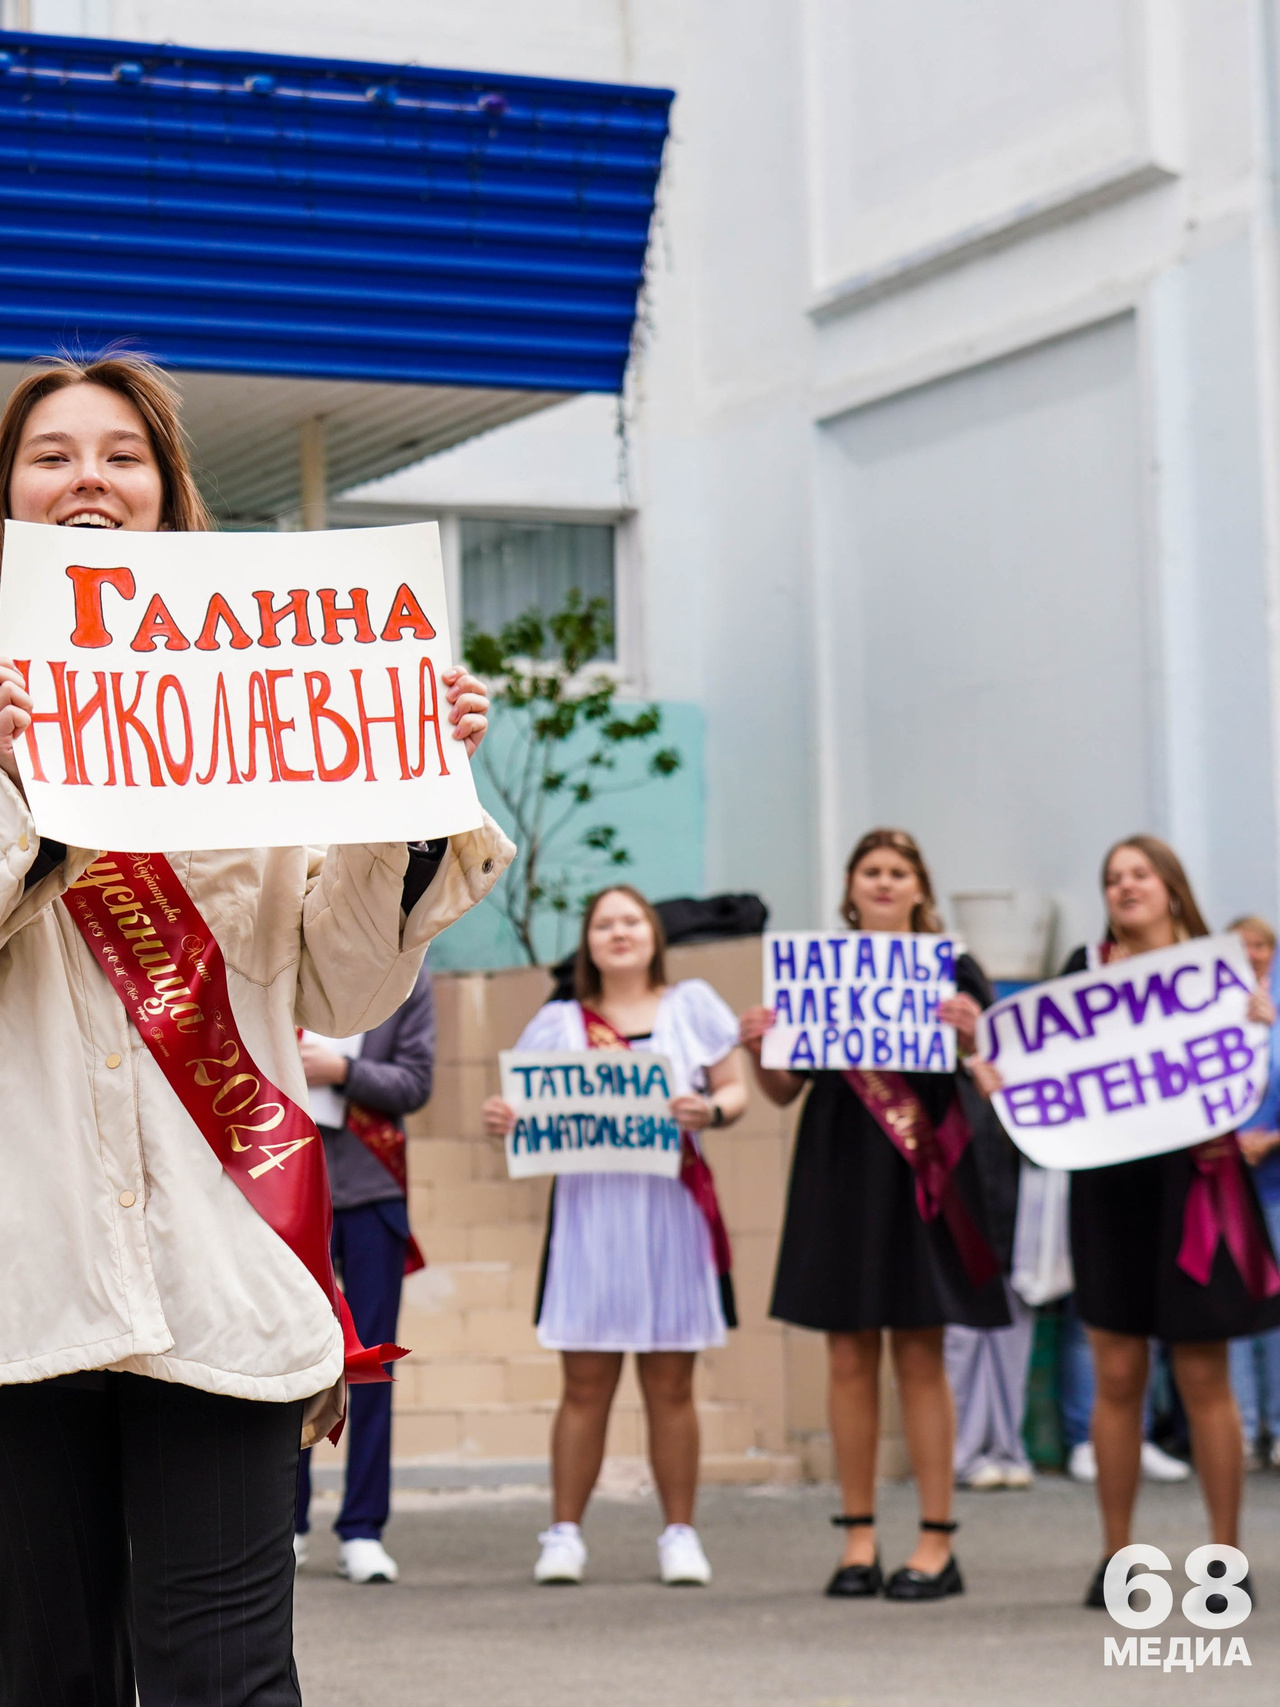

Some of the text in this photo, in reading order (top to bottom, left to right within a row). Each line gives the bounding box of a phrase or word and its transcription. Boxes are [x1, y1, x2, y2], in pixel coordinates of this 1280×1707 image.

[13, 657, 451, 788] НИКОЛАЕВНА
[181, 934, 212, 984] Алина
[773, 938, 956, 982] НАТАЛЬЯ
[67, 852, 315, 1180] ускница 2024
[985, 957, 1253, 1062] ЛАРИСА
[790, 1027, 947, 1069] ДРОВНА
[511, 1063, 670, 1099] ТАТЬЯНА
